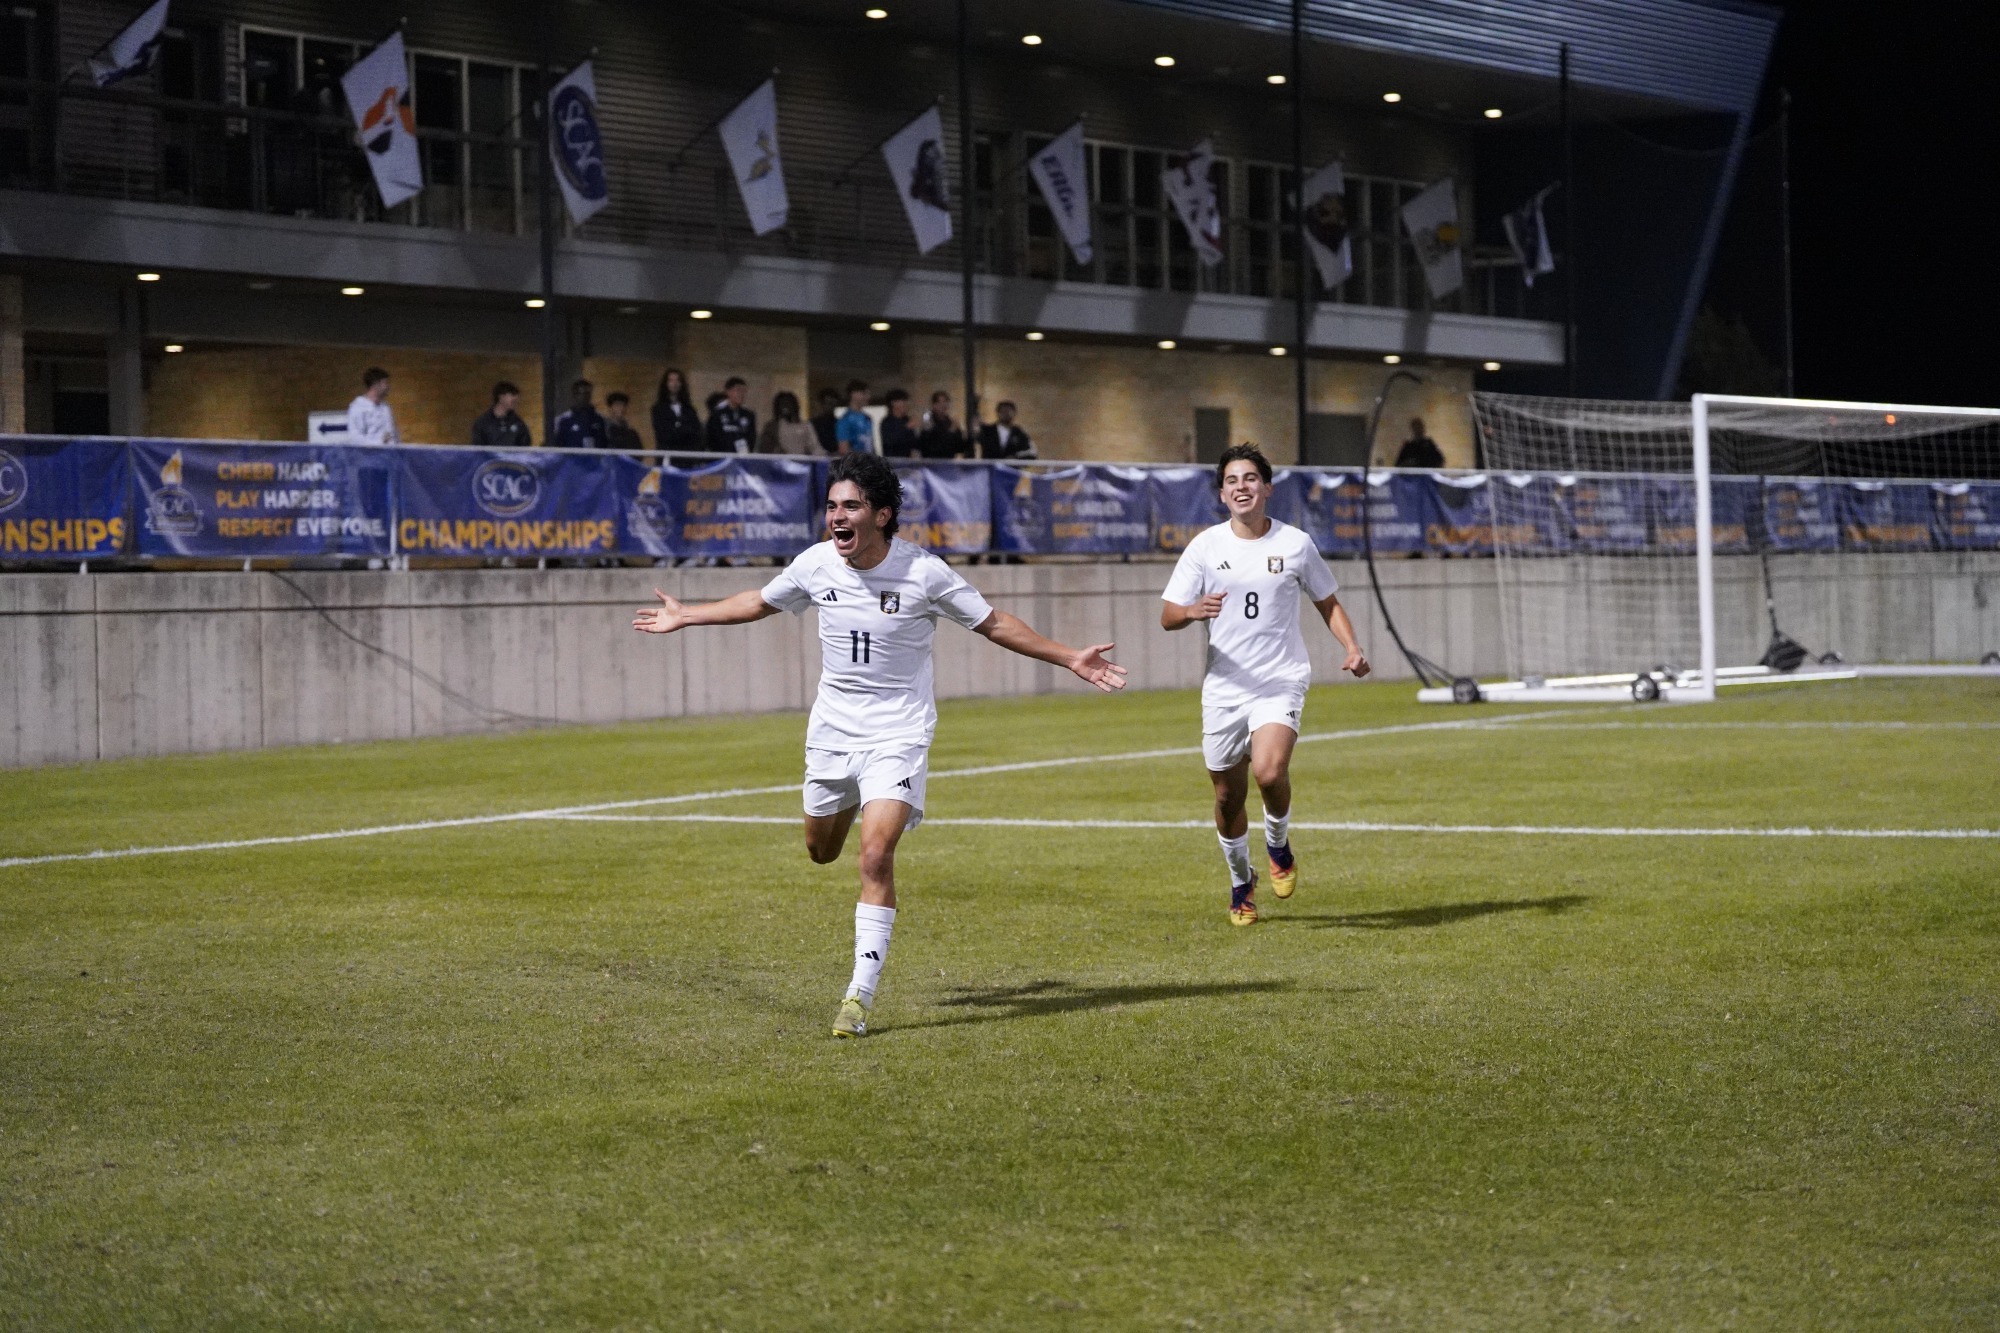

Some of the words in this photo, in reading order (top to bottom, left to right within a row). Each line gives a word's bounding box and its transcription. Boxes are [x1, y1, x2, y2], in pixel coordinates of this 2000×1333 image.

[217, 461, 275, 481] CHEER
[215, 489, 260, 509] PLAY
[481, 474, 531, 500] SCAC
[0, 517, 124, 552] NSHIPS
[218, 517, 293, 537] RESPECT
[400, 518, 614, 550] CHAMPIONSHIPS
[1244, 591, 1259, 620] 8
[850, 630, 870, 664] 11
